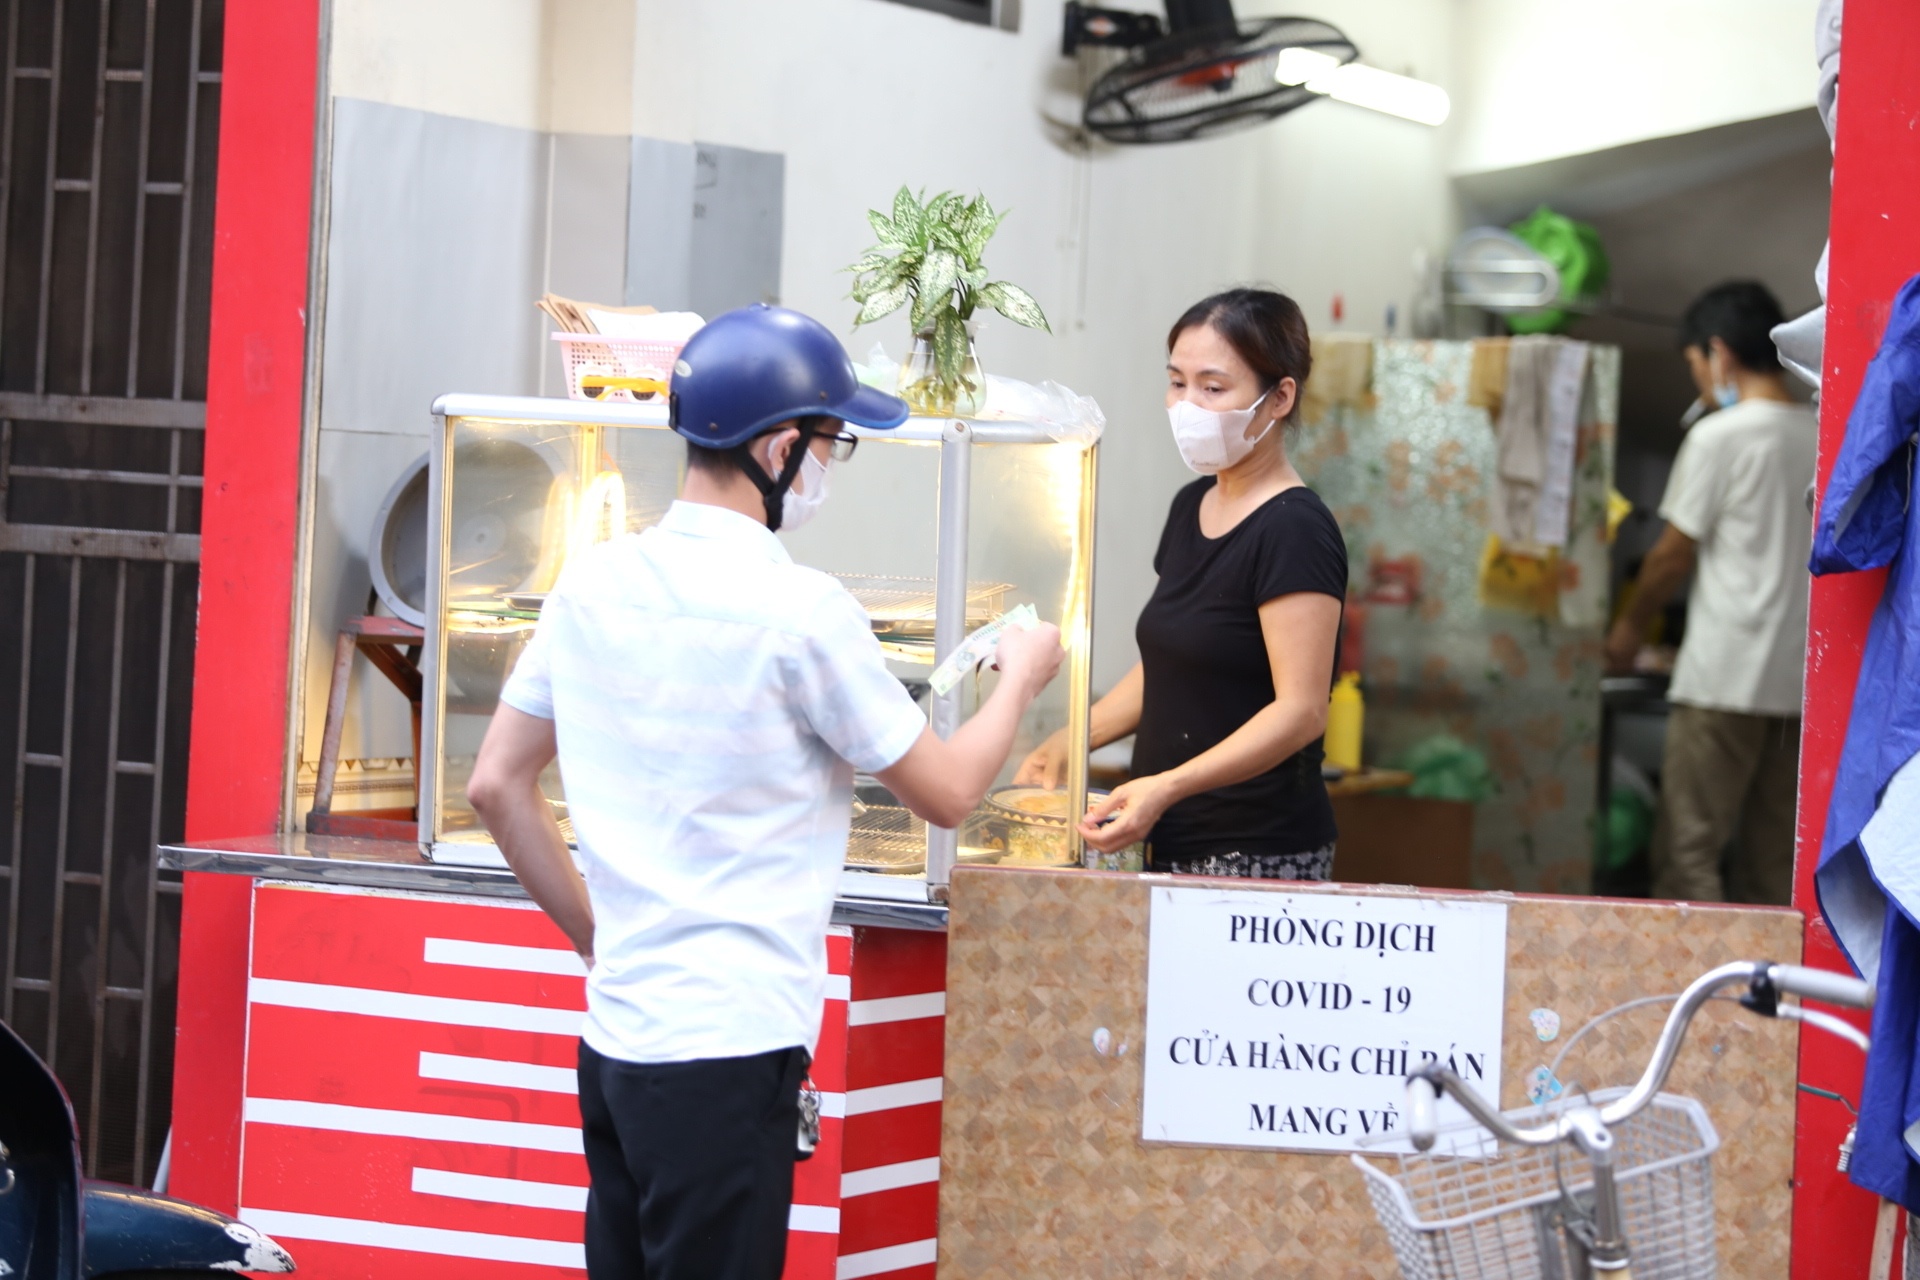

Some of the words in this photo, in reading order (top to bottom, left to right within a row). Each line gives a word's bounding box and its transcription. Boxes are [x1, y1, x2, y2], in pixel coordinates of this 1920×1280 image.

[1229, 908, 1344, 948] PHÒNG
[1355, 921, 1436, 958] DỊCH
[1247, 978, 1353, 1010] COVID
[1384, 986, 1412, 1014] 19
[1168, 1029, 1238, 1068] CỬA
[1247, 1034, 1340, 1073] HÀNG
[1350, 1040, 1409, 1077] CHỈ
[1249, 1103, 1348, 1136] MANG
